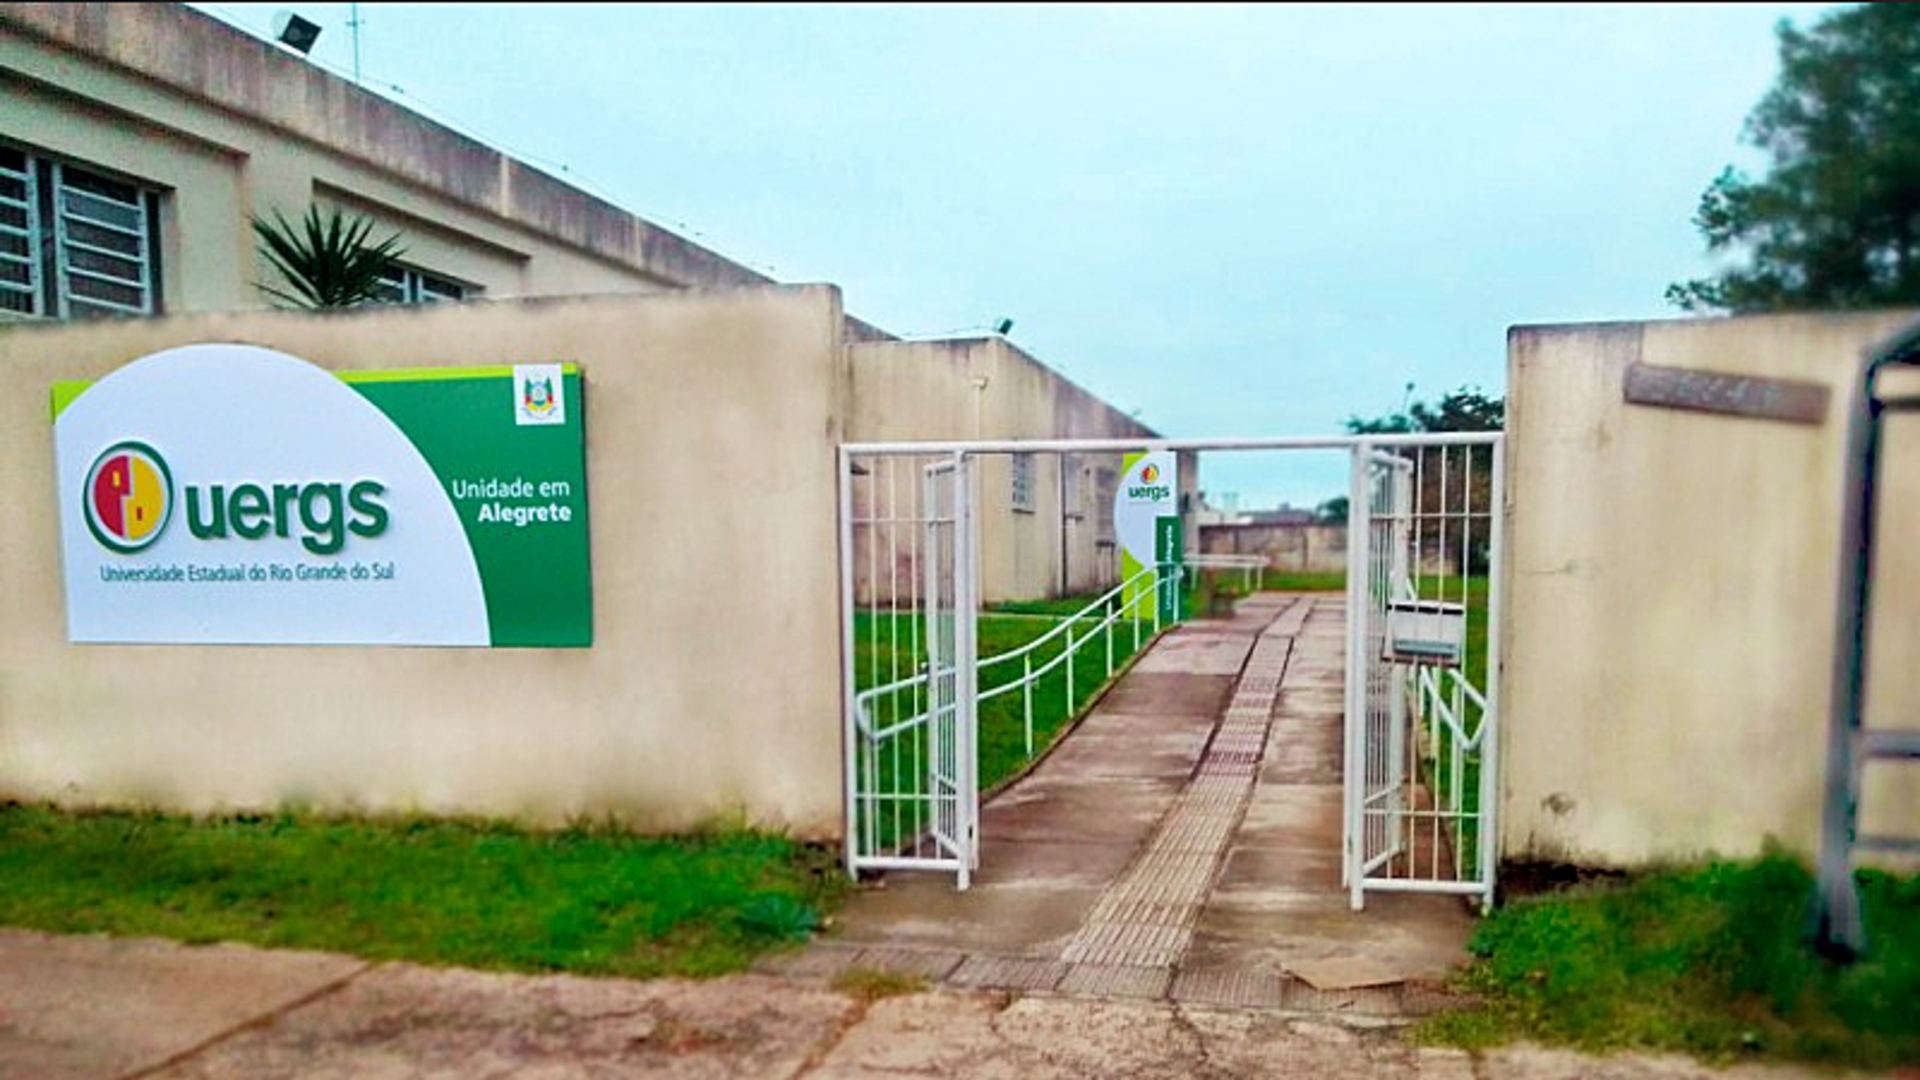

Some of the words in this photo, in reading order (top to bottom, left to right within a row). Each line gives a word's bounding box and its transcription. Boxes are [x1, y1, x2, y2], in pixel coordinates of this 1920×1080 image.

[452, 476, 534, 499] Unidade
[539, 481, 571, 498] em
[1128, 485, 1170, 502] uergs
[185, 479, 390, 556] uergs
[477, 502, 572, 526] Alegrete
[100, 565, 185, 582] Universidade
[188, 564, 245, 582] Estadual
[248, 565, 267, 582] do
[270, 564, 293, 581] Rio
[296, 563, 347, 581] Grande
[350, 562, 370, 580] do
[374, 562, 395, 579] Sul
